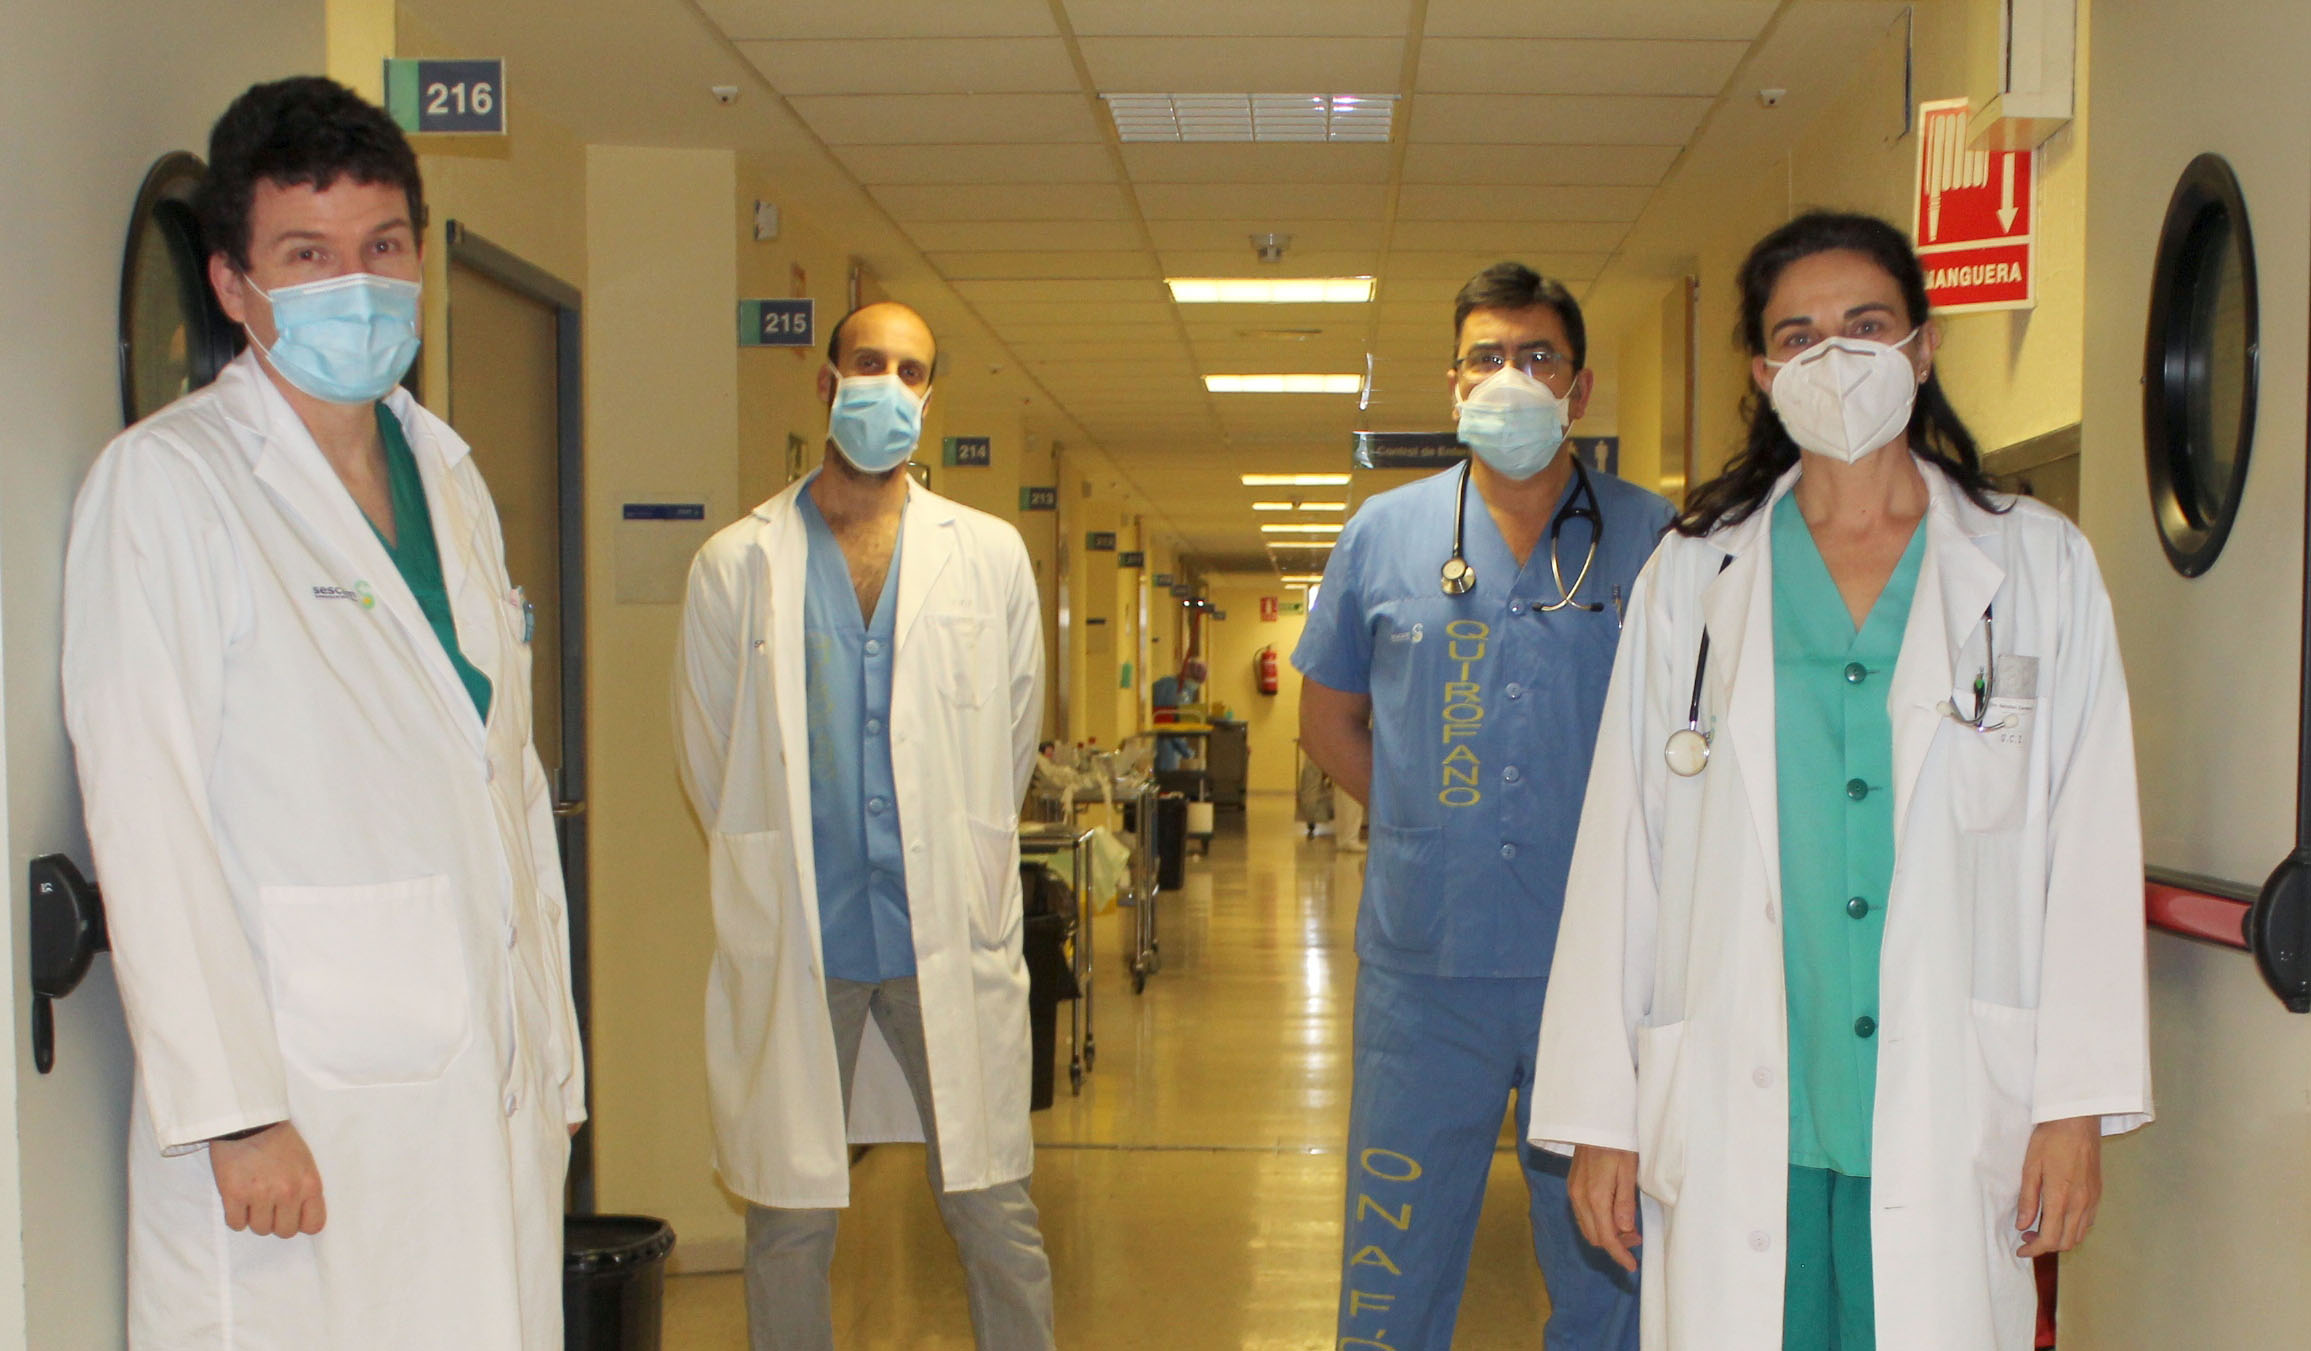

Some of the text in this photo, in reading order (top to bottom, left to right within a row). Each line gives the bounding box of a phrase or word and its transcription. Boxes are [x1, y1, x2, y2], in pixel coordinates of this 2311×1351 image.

[426, 82, 493, 114] 216
[765, 312, 807, 333] 215
[958, 444, 987, 460] 214
